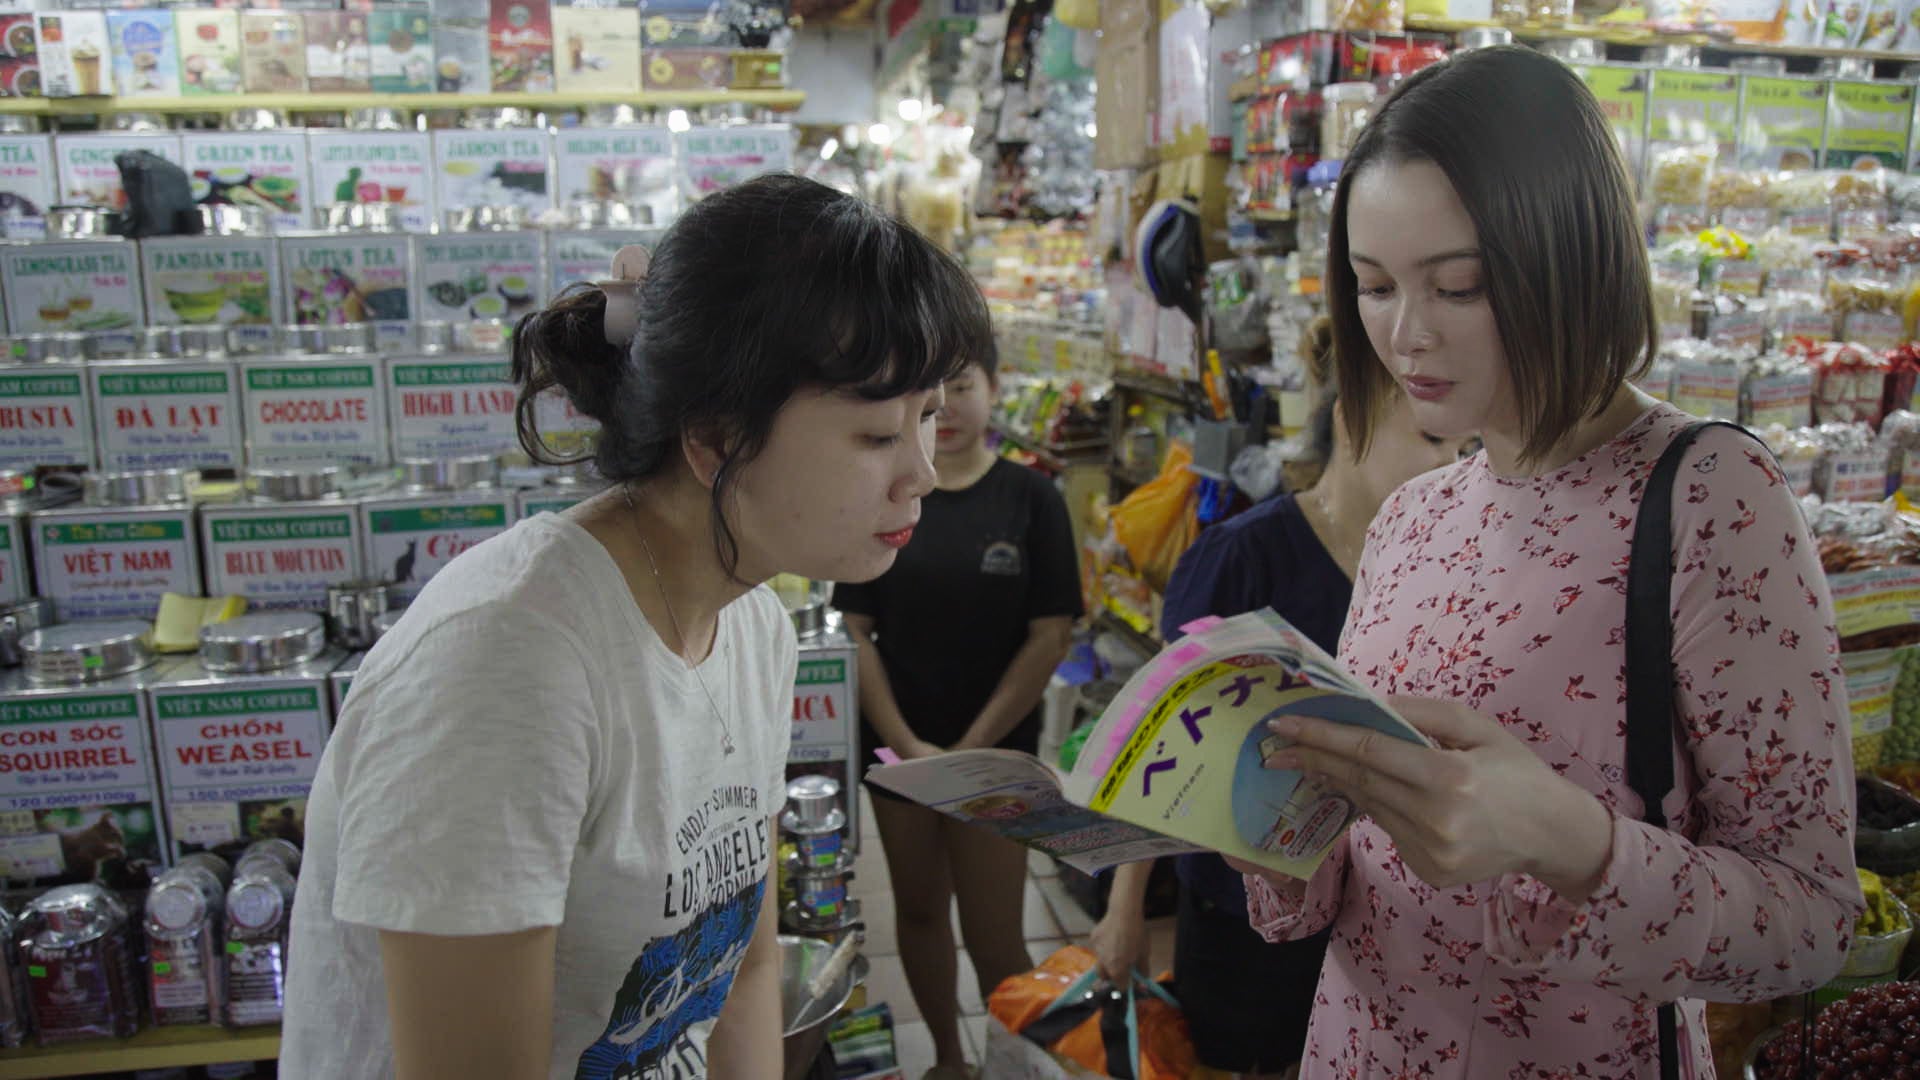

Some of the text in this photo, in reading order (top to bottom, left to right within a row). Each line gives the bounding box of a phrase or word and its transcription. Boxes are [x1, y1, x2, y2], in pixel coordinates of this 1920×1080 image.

[258, 144, 295, 163] TEA
[511, 138, 541, 157] TEA
[230, 251, 264, 268] TEA
[361, 249, 396, 265] TEA
[260, 399, 367, 423] CHOCOLATE
[403, 393, 453, 417] HIGH
[292, 518, 346, 536] COFFEE
[63, 548, 173, 575] VIỆT NAM
[224, 550, 268, 575] BLUE
[27, 701, 64, 717] NAM
[67, 698, 132, 716] COFFEE
[207, 695, 247, 710] NAM
[251, 692, 313, 708] COFFEE
[1, 730, 57, 746] CON
[0, 746, 136, 773] SQUIRREL
[177, 741, 312, 766] WEASEL
[712, 786, 758, 811] SUMMER
[1162, 762, 1205, 819] Vietnam
